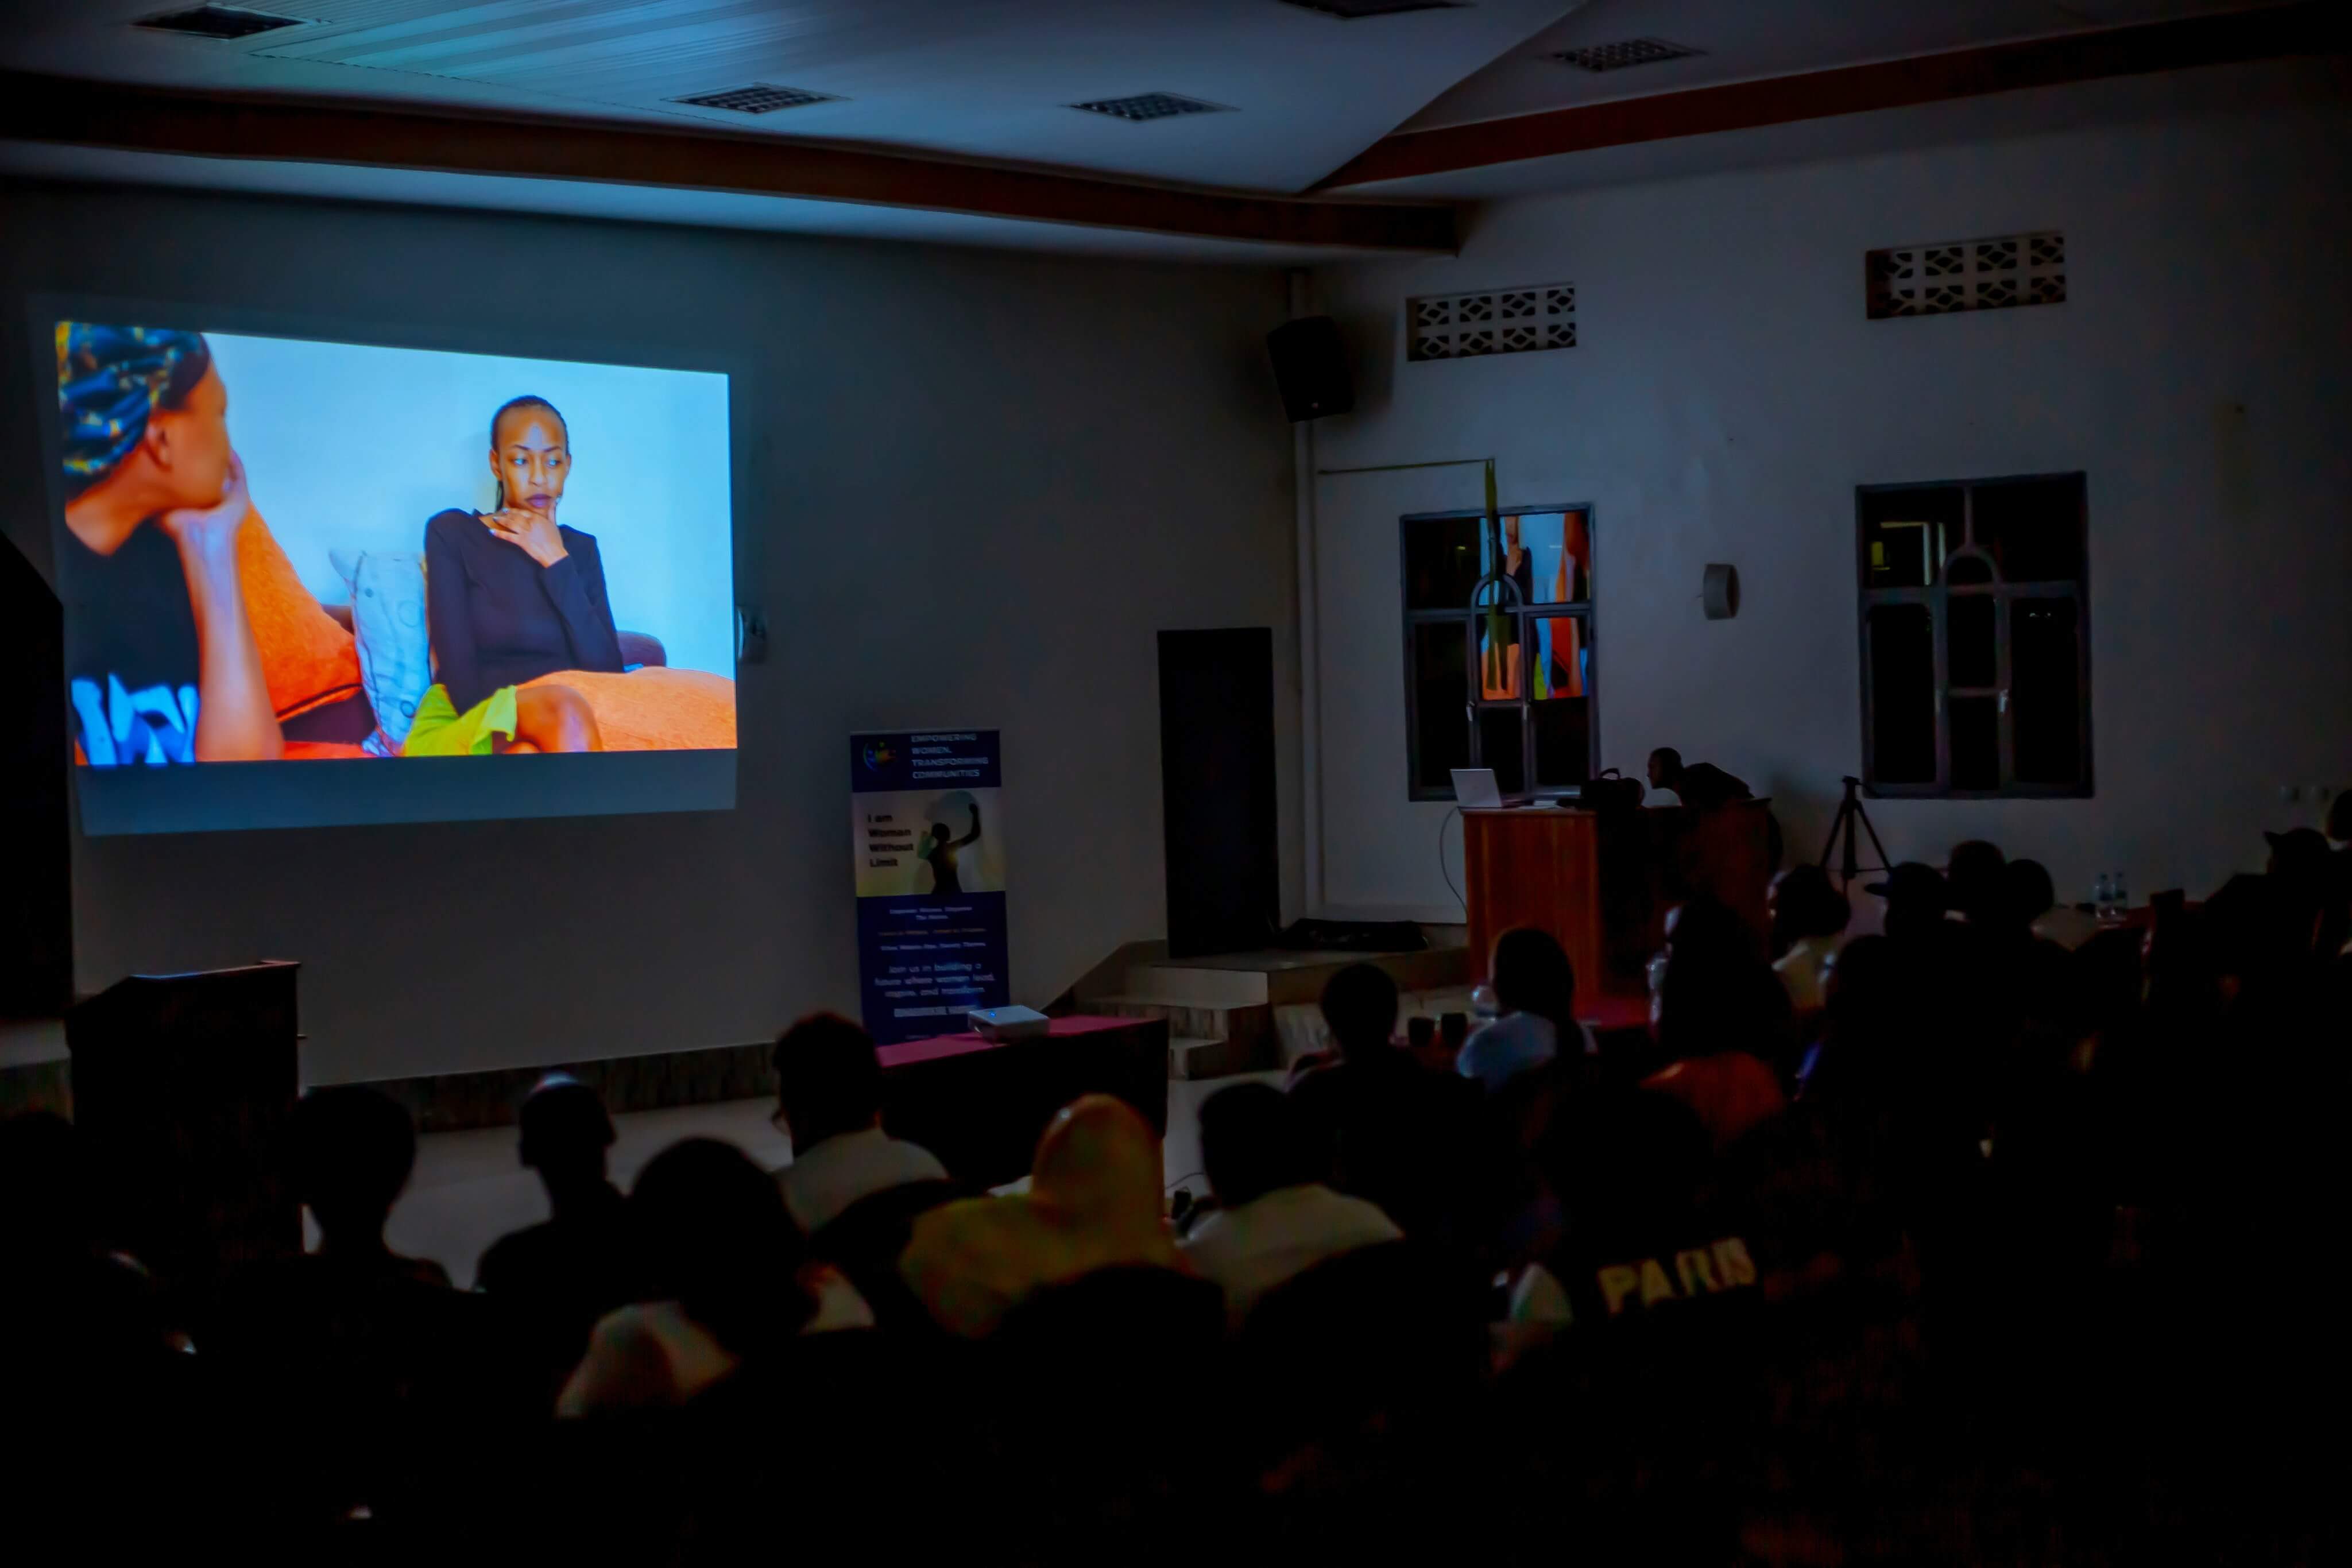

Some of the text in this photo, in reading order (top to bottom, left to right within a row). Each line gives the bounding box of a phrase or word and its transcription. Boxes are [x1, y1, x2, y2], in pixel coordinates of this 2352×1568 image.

[911, 757, 989, 767] TRANSFORMING
[912, 769, 980, 779] COMMUNITIES
[870, 859, 898, 867] Limit
